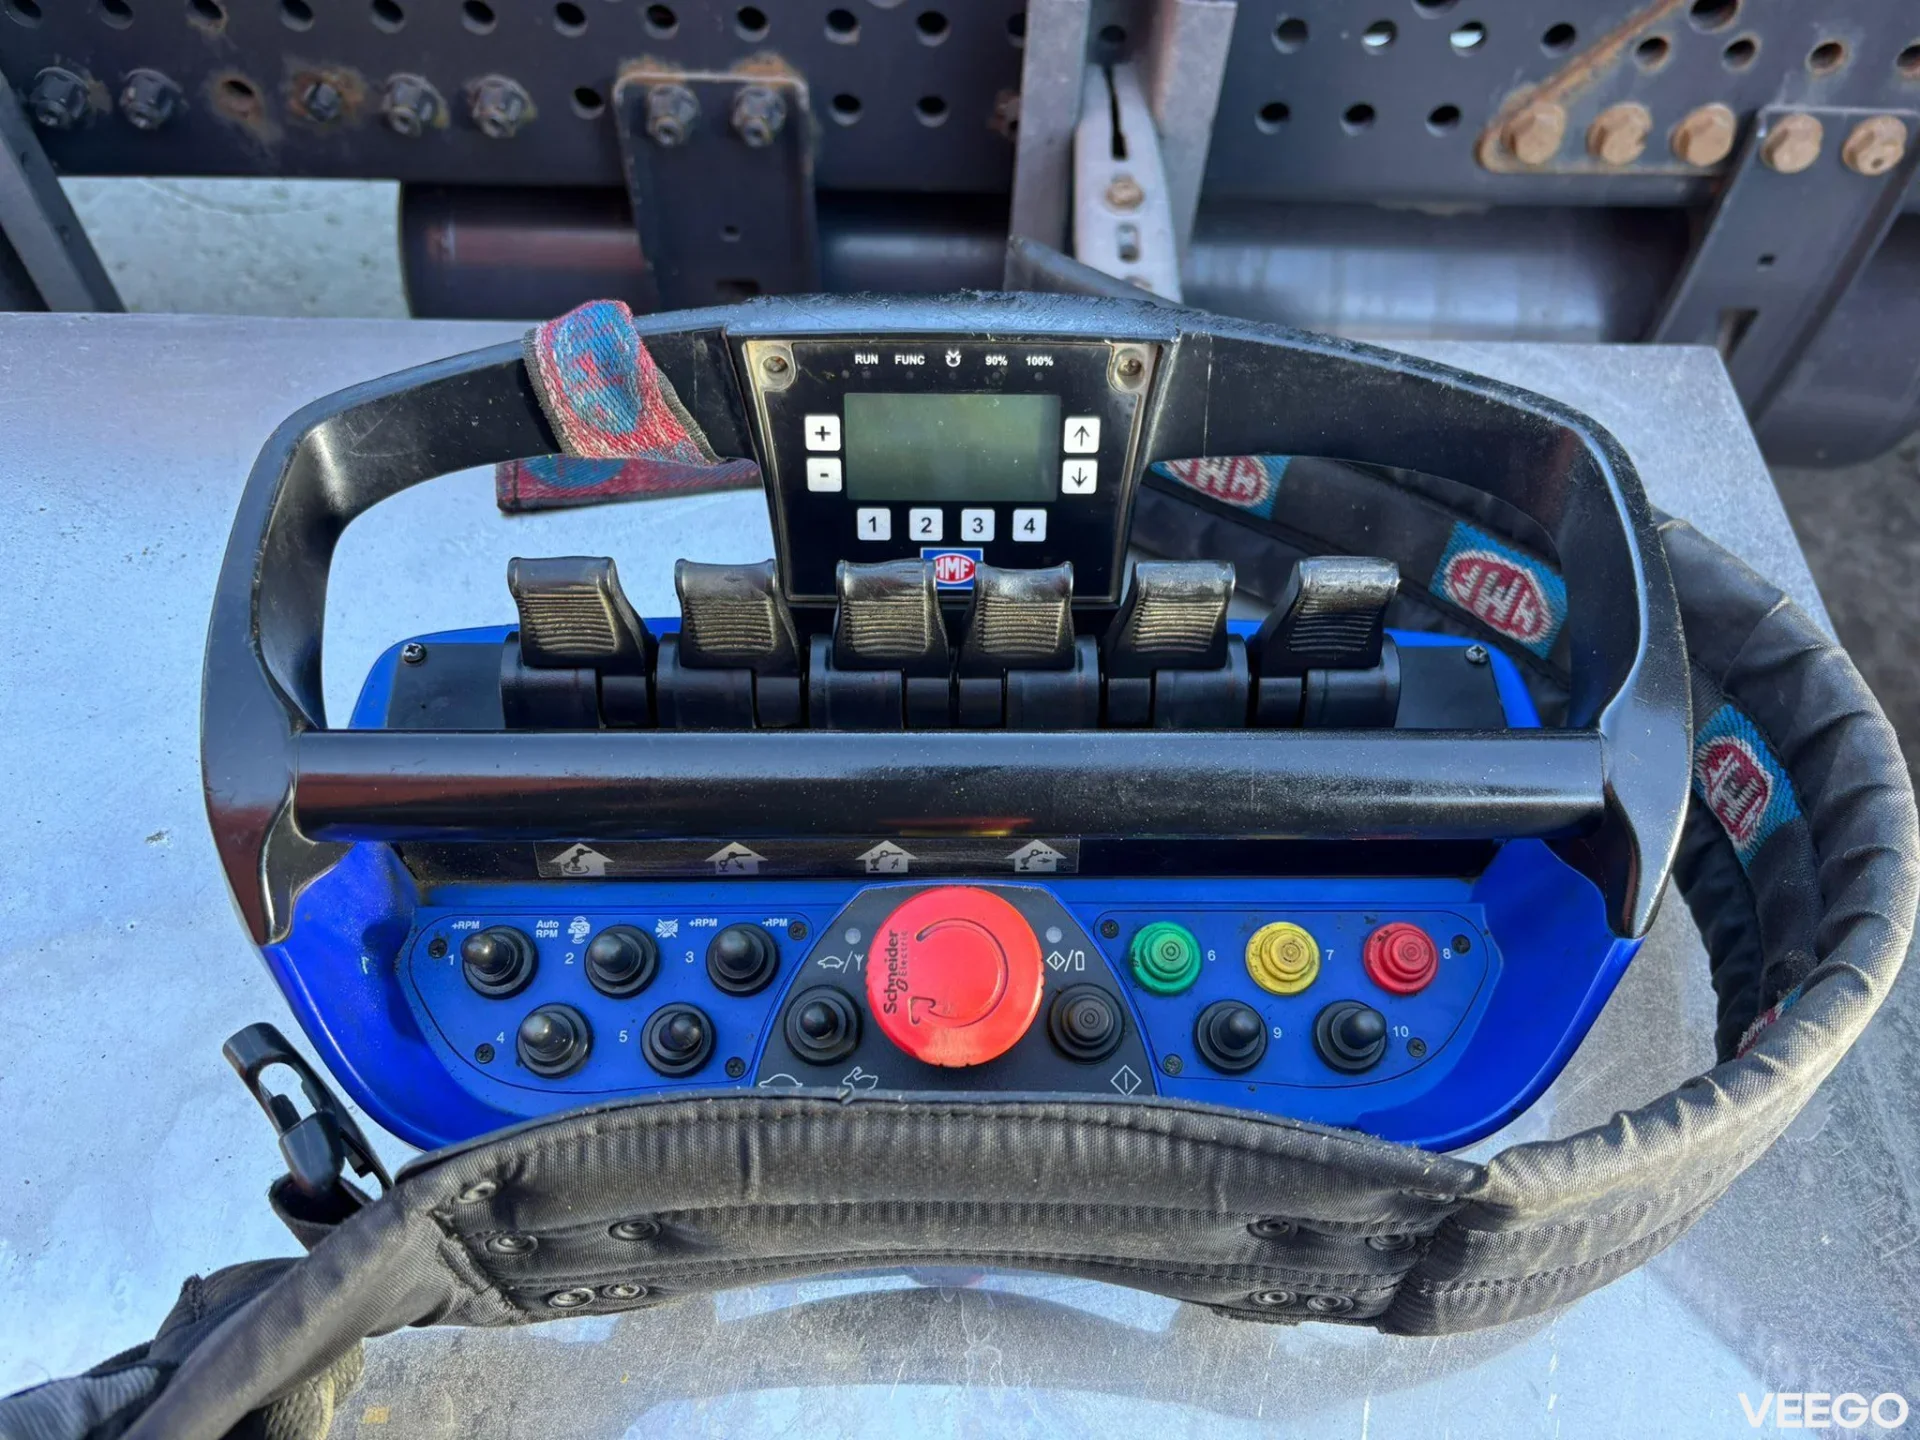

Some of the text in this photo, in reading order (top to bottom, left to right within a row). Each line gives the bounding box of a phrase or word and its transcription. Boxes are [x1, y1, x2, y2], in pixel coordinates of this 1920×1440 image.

[854, 353, 879, 365] RUN
[894, 354, 925, 366] FUNC
[985, 355, 1008, 366] 90%
[1025, 355, 1054, 367] 100%
[868, 516, 877, 532] 1
[920, 516, 932, 533] 2
[972, 517, 984, 534] 3
[1023, 517, 1036, 533] 4
[936, 557, 970, 580] HMF
[451, 920, 480, 930] +RPM
[536, 919, 560, 929] Auto
[689, 917, 718, 927] +RPM
[535, 929, 558, 938] RPM
[448, 954, 455, 966] 1
[564, 952, 575, 965] 2
[685, 950, 694, 964] 3
[1207, 949, 1217, 962] 6
[1325, 949, 1335, 961] 7
[1442, 947, 1452, 960] 8
[883, 930, 899, 1014] Schneider
[496, 1031, 505, 1044] 4
[619, 1029, 628, 1043] 5
[1273, 1026, 1283, 1039] 9
[1392, 1025, 1409, 1038] 10
